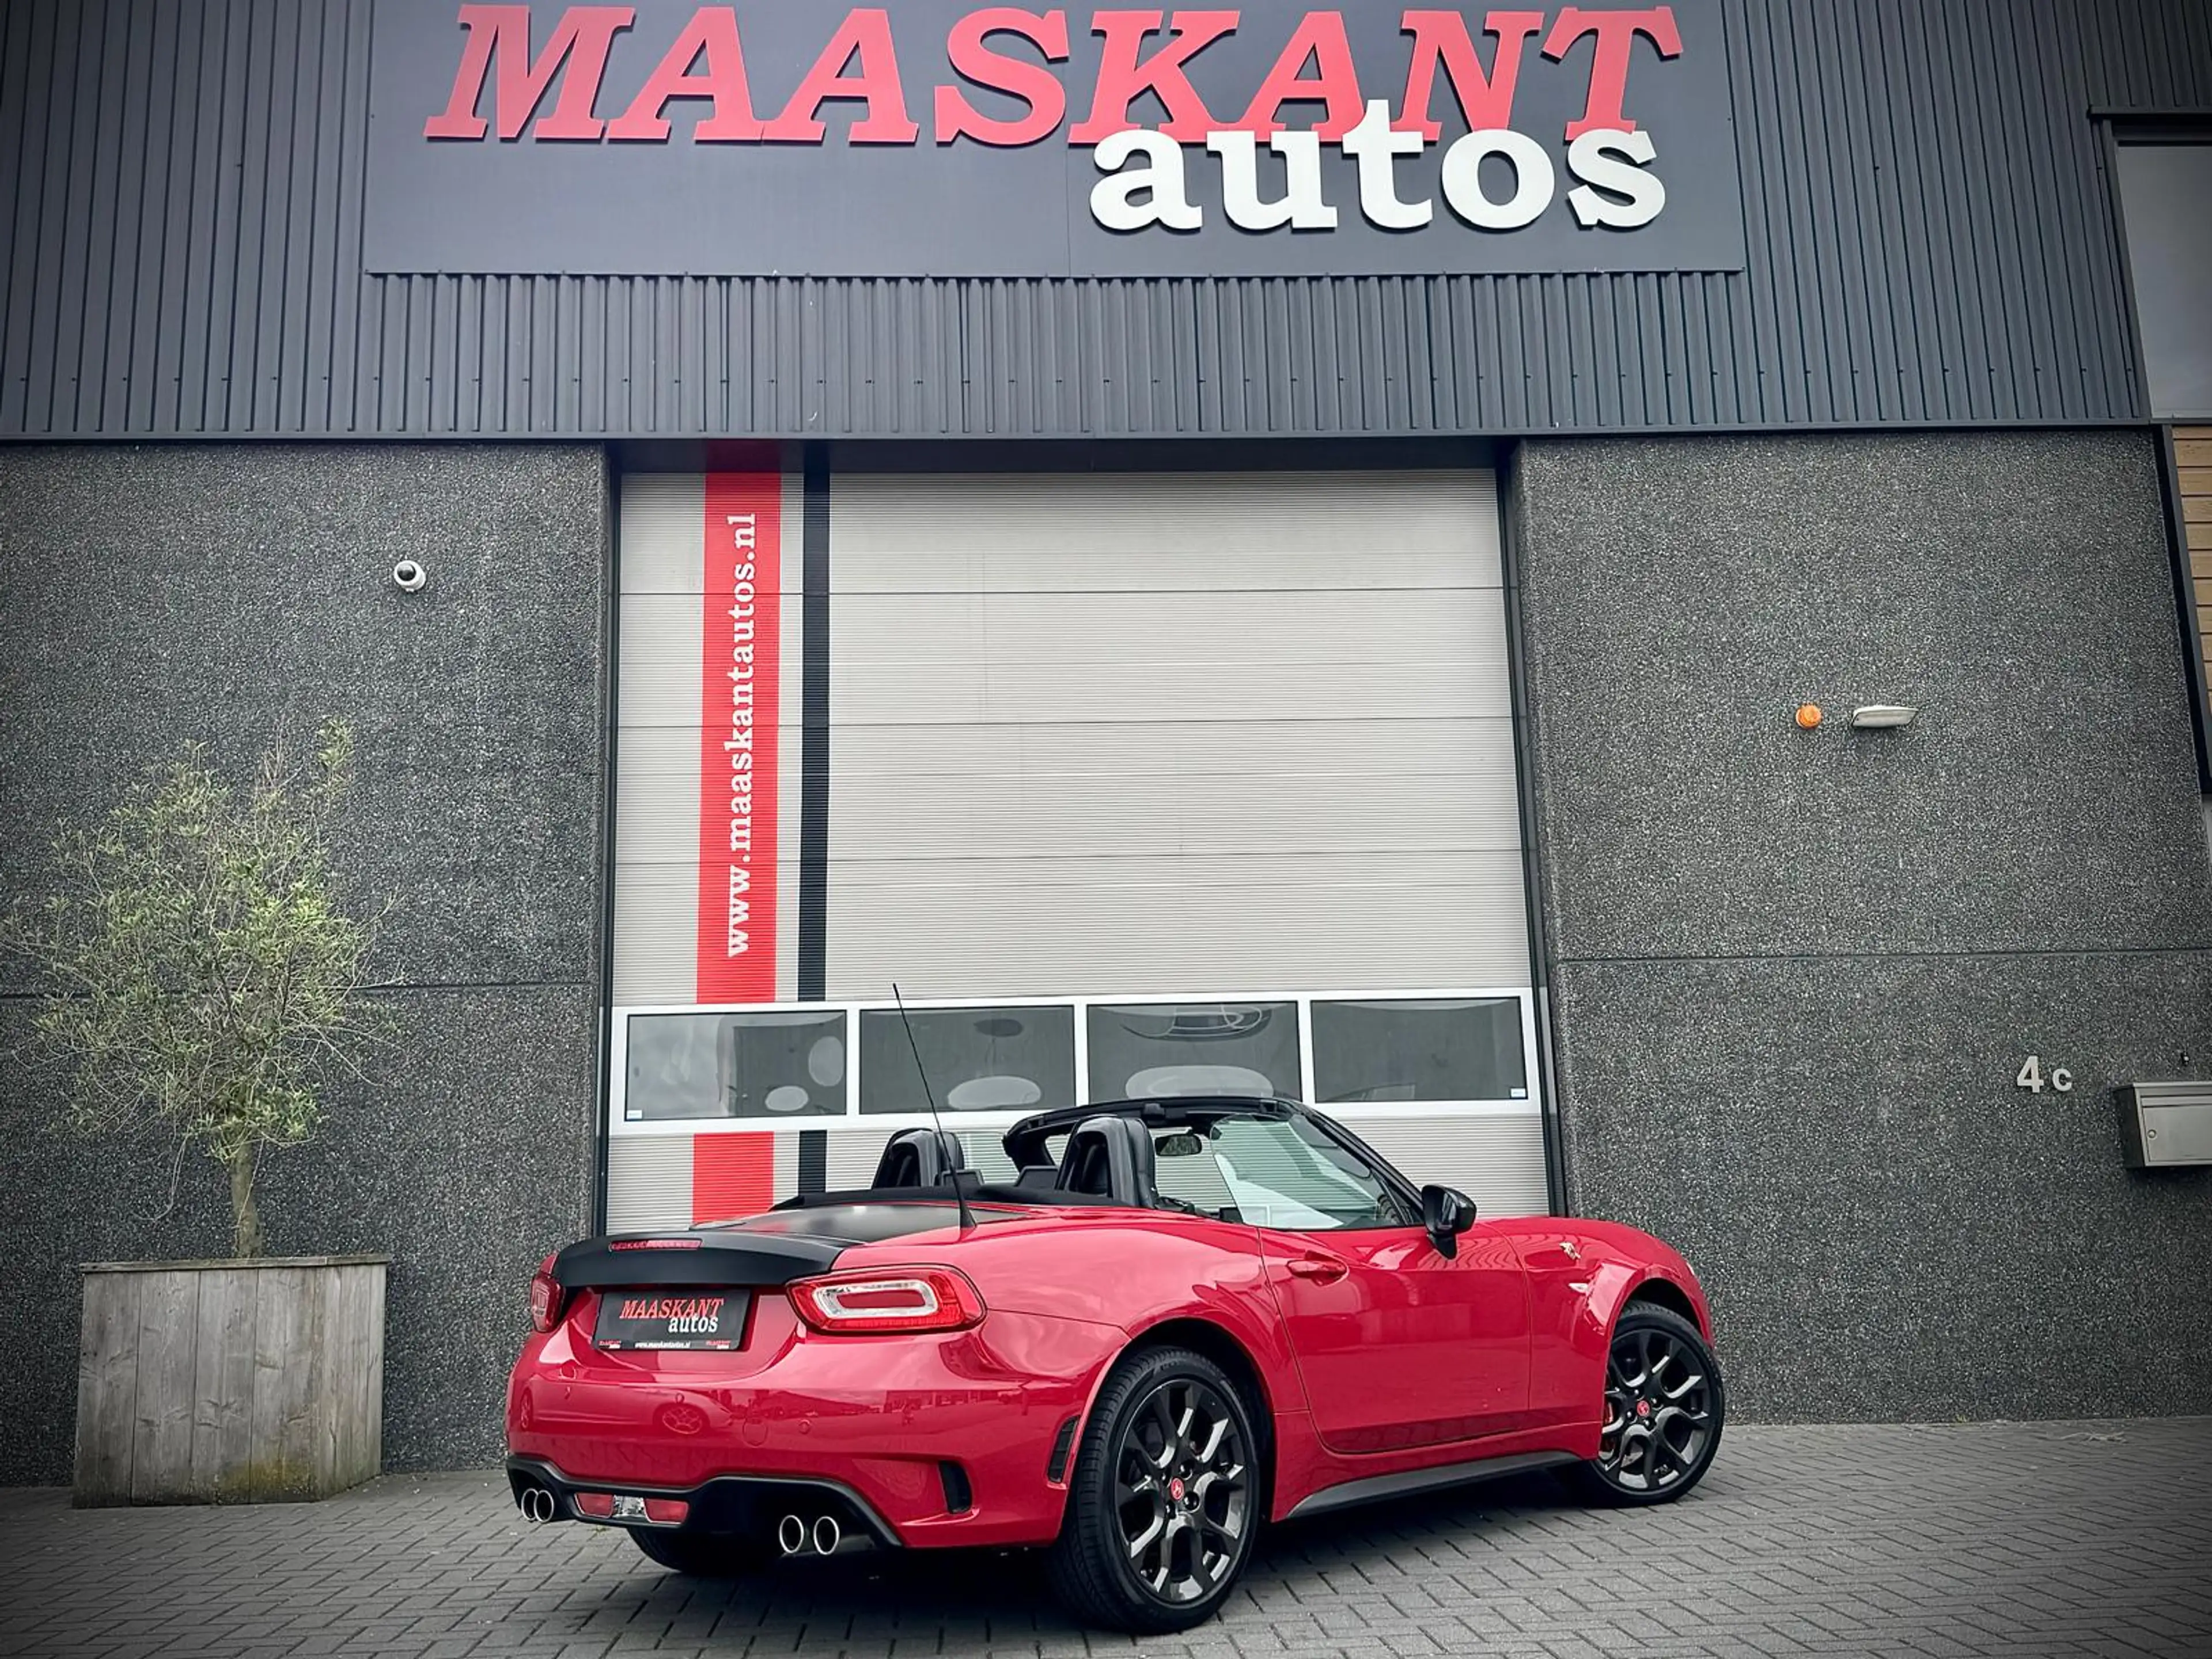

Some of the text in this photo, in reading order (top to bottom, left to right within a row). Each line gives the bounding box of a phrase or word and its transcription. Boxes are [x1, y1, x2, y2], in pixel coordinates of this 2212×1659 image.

[424, 6, 1684, 145] MAASKANT
[1089, 99, 1666, 229] autos
[724, 513, 756, 958] www.maaskantautos.nl
[619, 1297, 724, 1319] MAASKANT
[668, 1313, 718, 1333] autos
